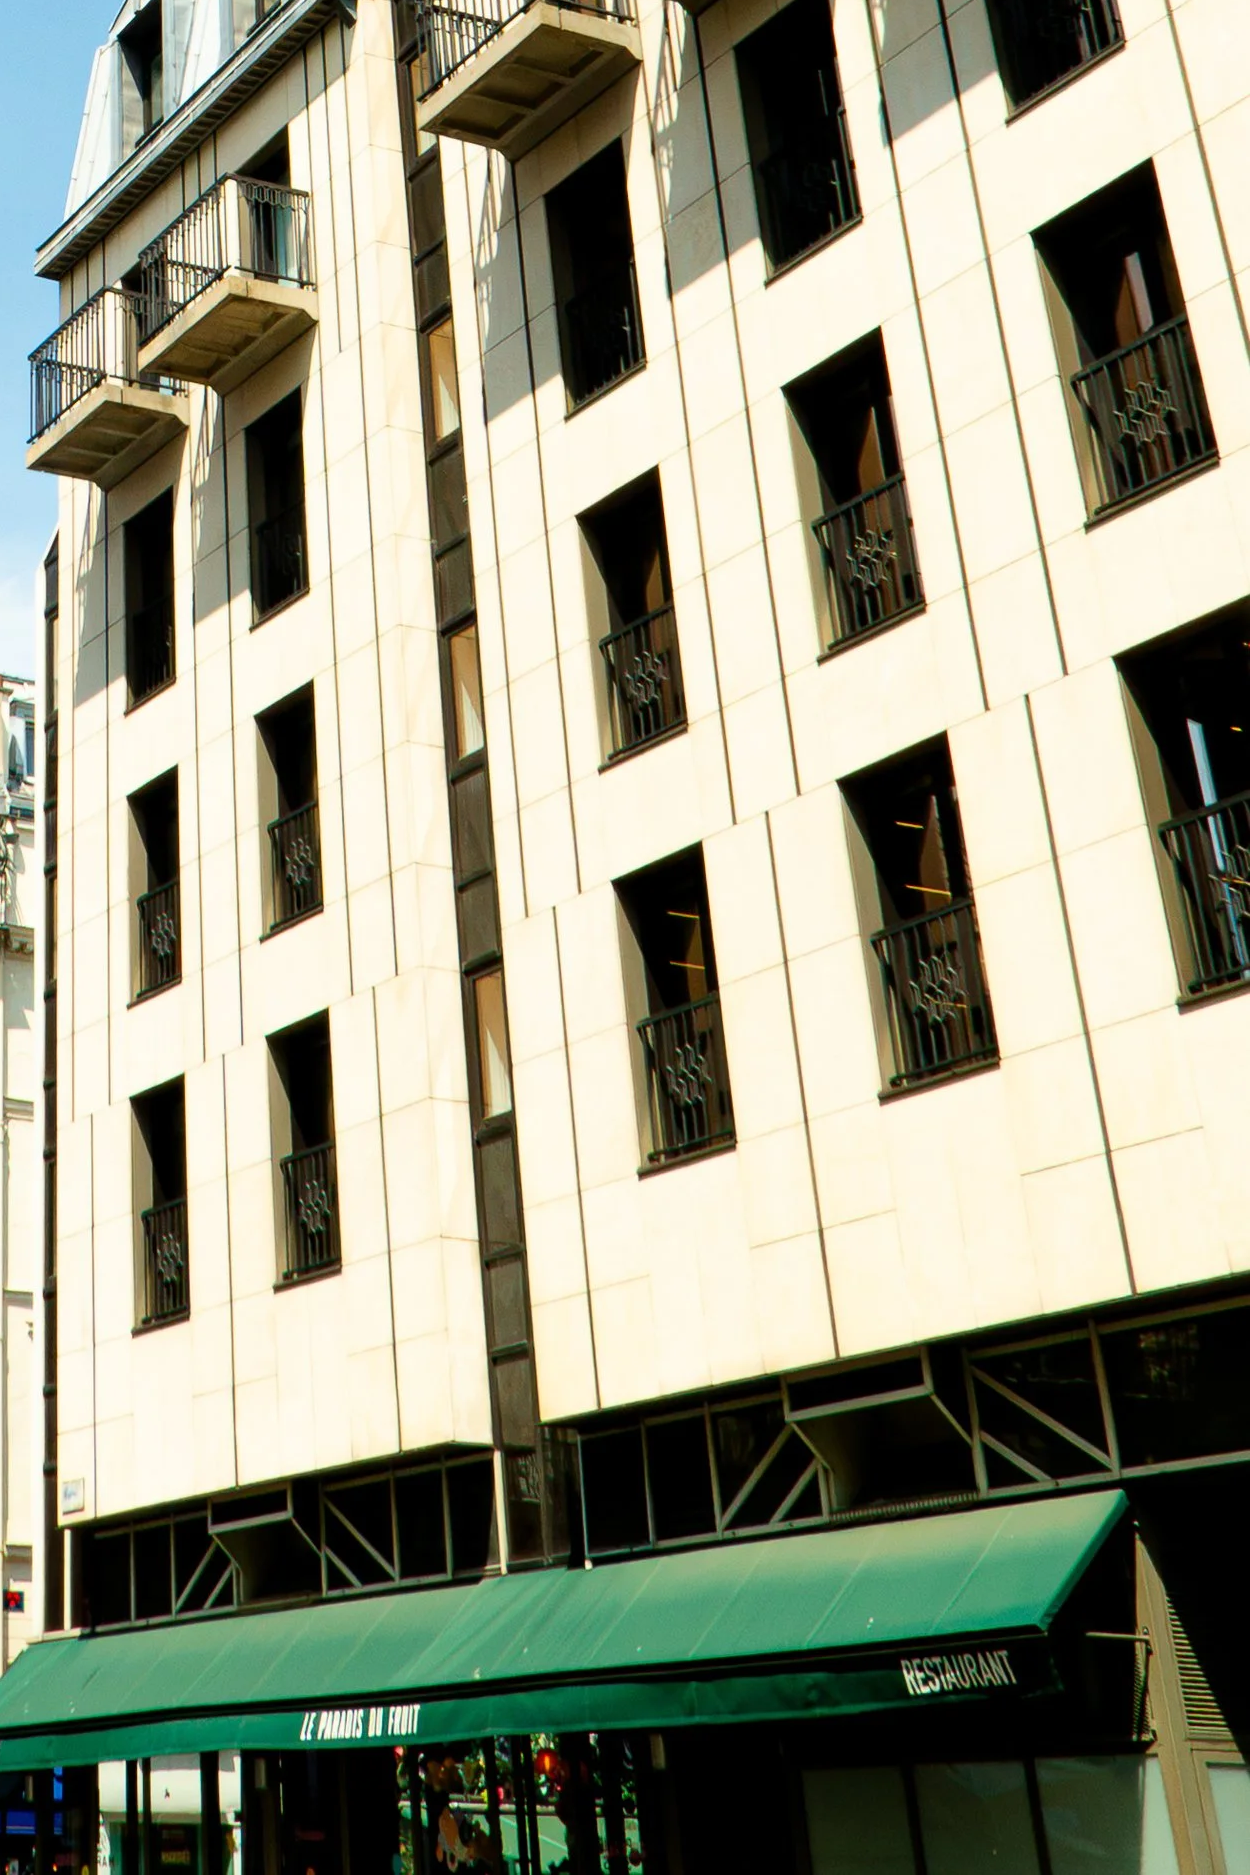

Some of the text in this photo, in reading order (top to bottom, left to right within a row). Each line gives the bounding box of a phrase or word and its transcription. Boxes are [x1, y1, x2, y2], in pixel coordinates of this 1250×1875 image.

[900, 1650, 1017, 1695] RESTAURANT
[299, 1703, 421, 1741] LE PARADIS DU FRUIT
